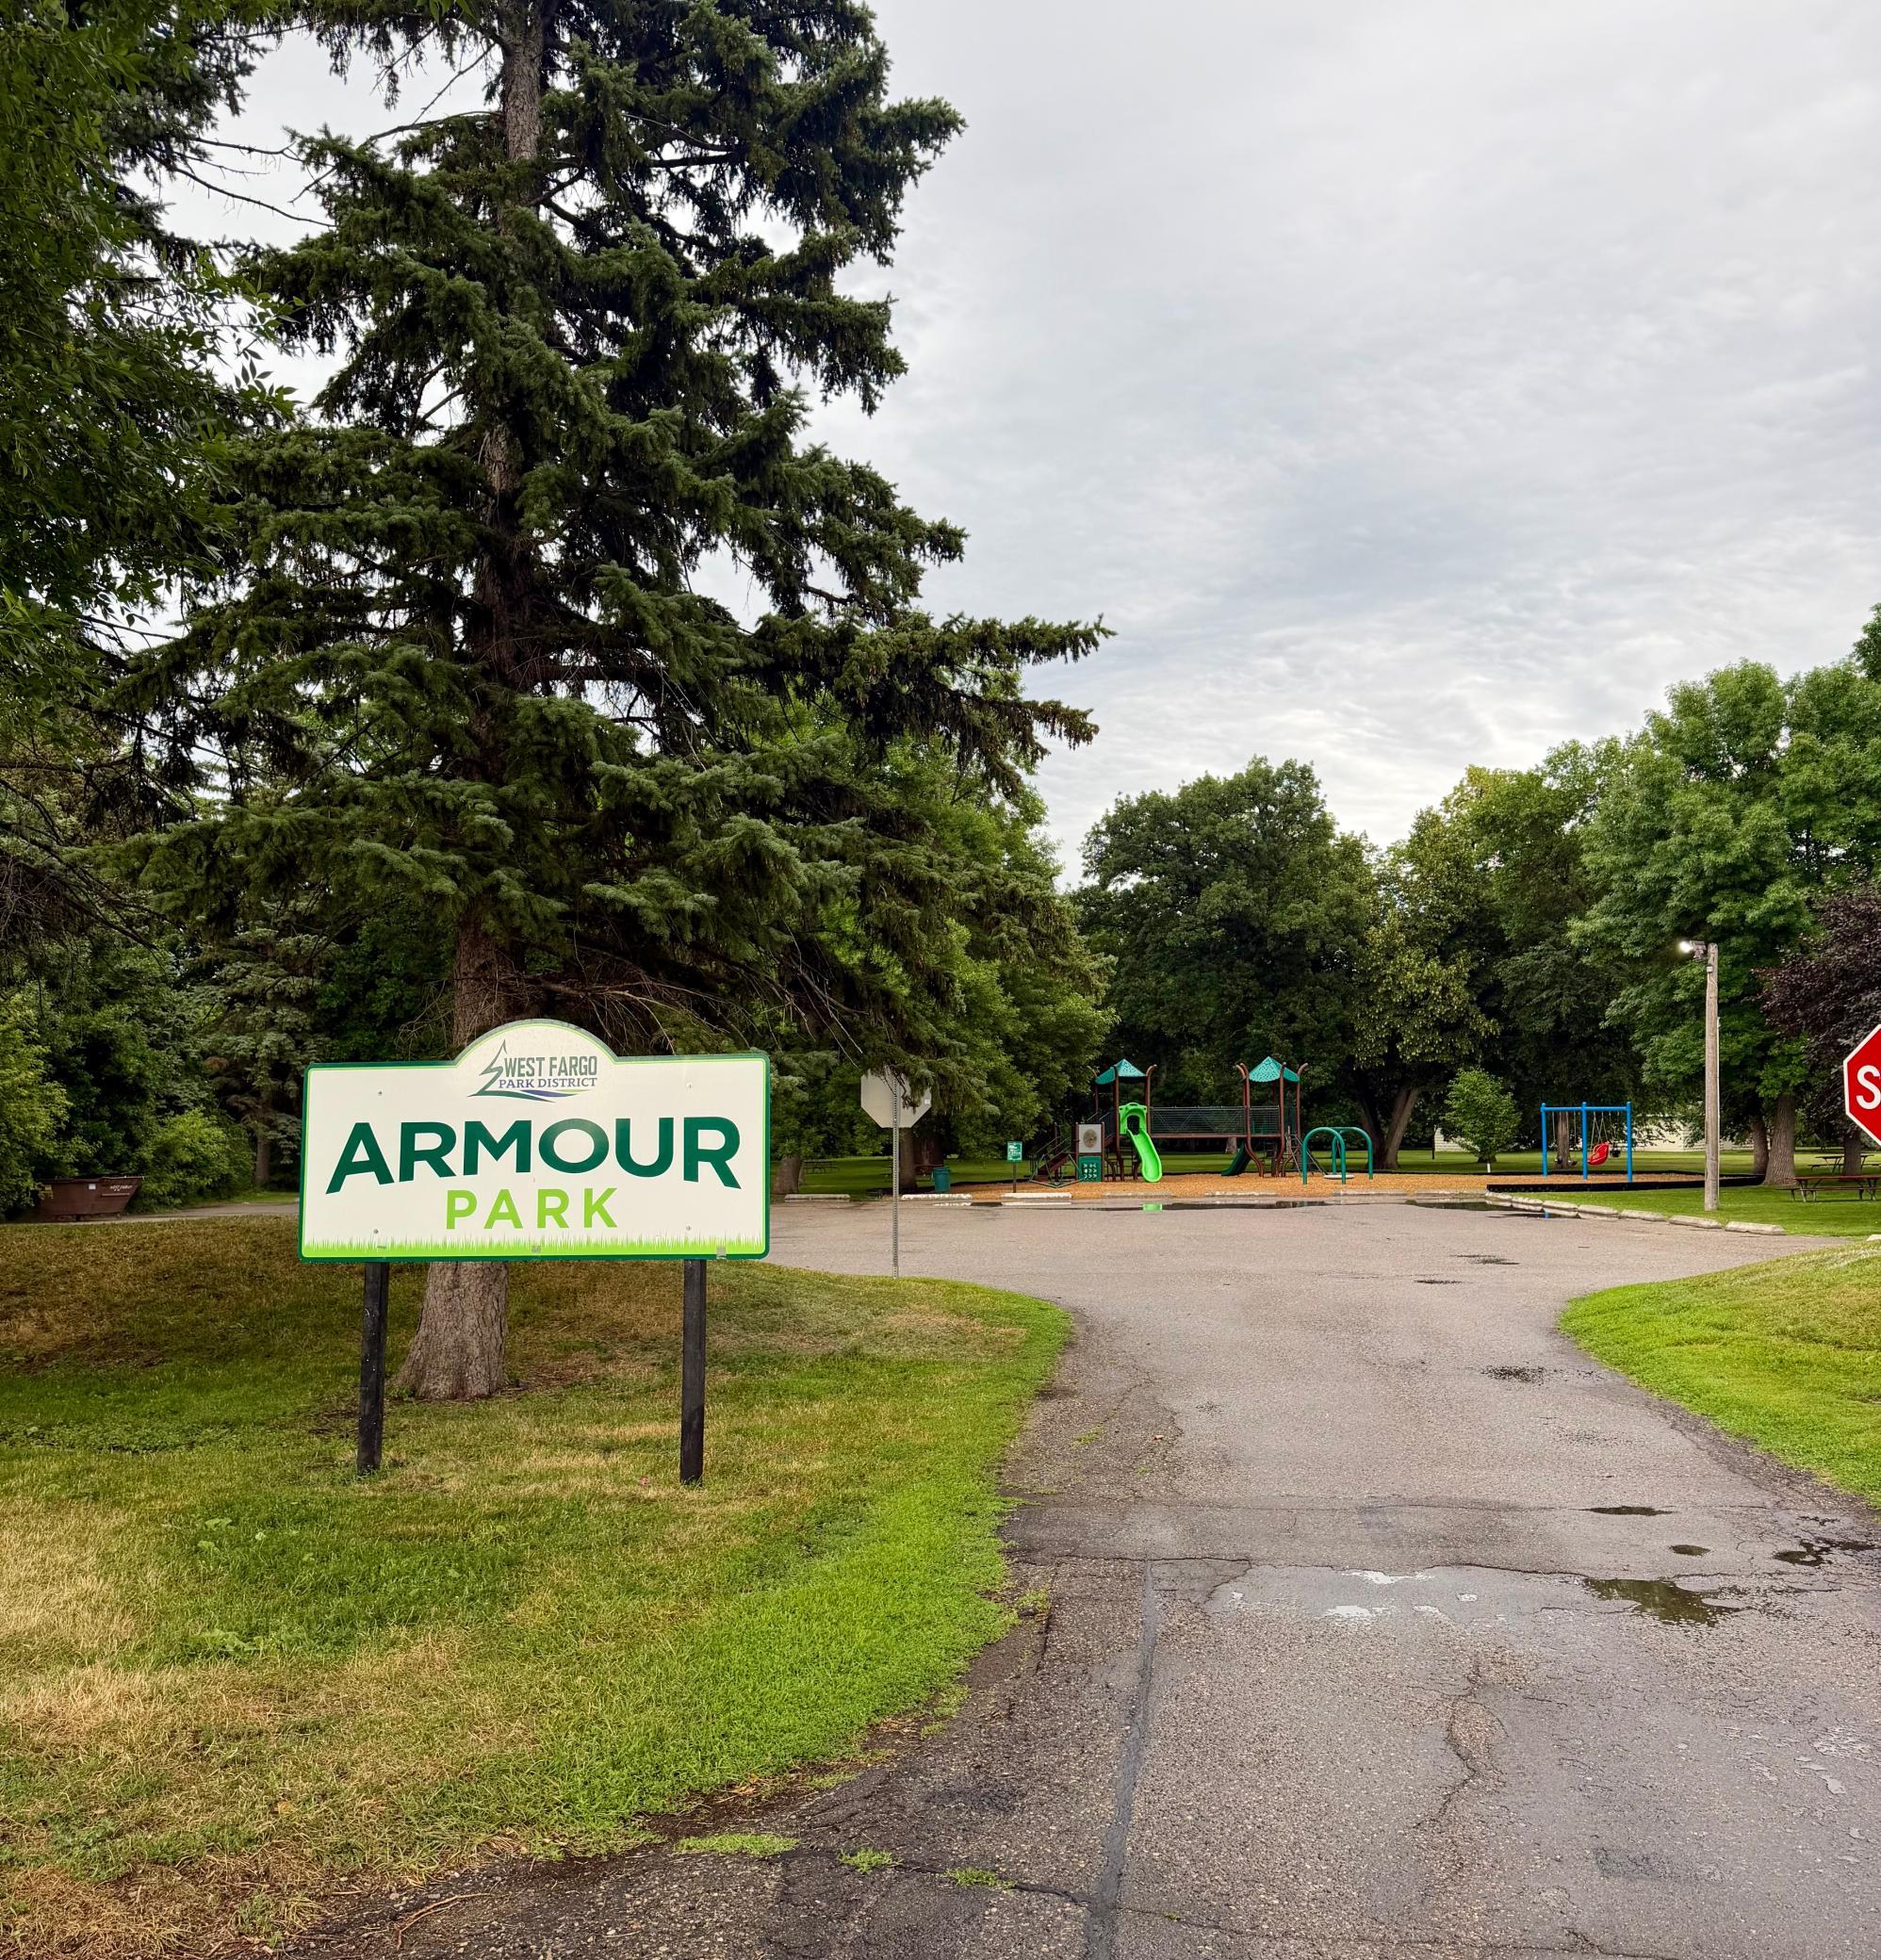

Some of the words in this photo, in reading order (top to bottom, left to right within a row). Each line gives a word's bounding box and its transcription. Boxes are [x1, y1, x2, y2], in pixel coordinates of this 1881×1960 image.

[504, 1056, 545, 1077] WEST
[549, 1055, 597, 1076] FARGO
[499, 1079, 534, 1089] PARK
[538, 1077, 597, 1087] DISTRICT
[325, 1116, 742, 1195] ARMOUR
[447, 1187, 617, 1230] PARK
